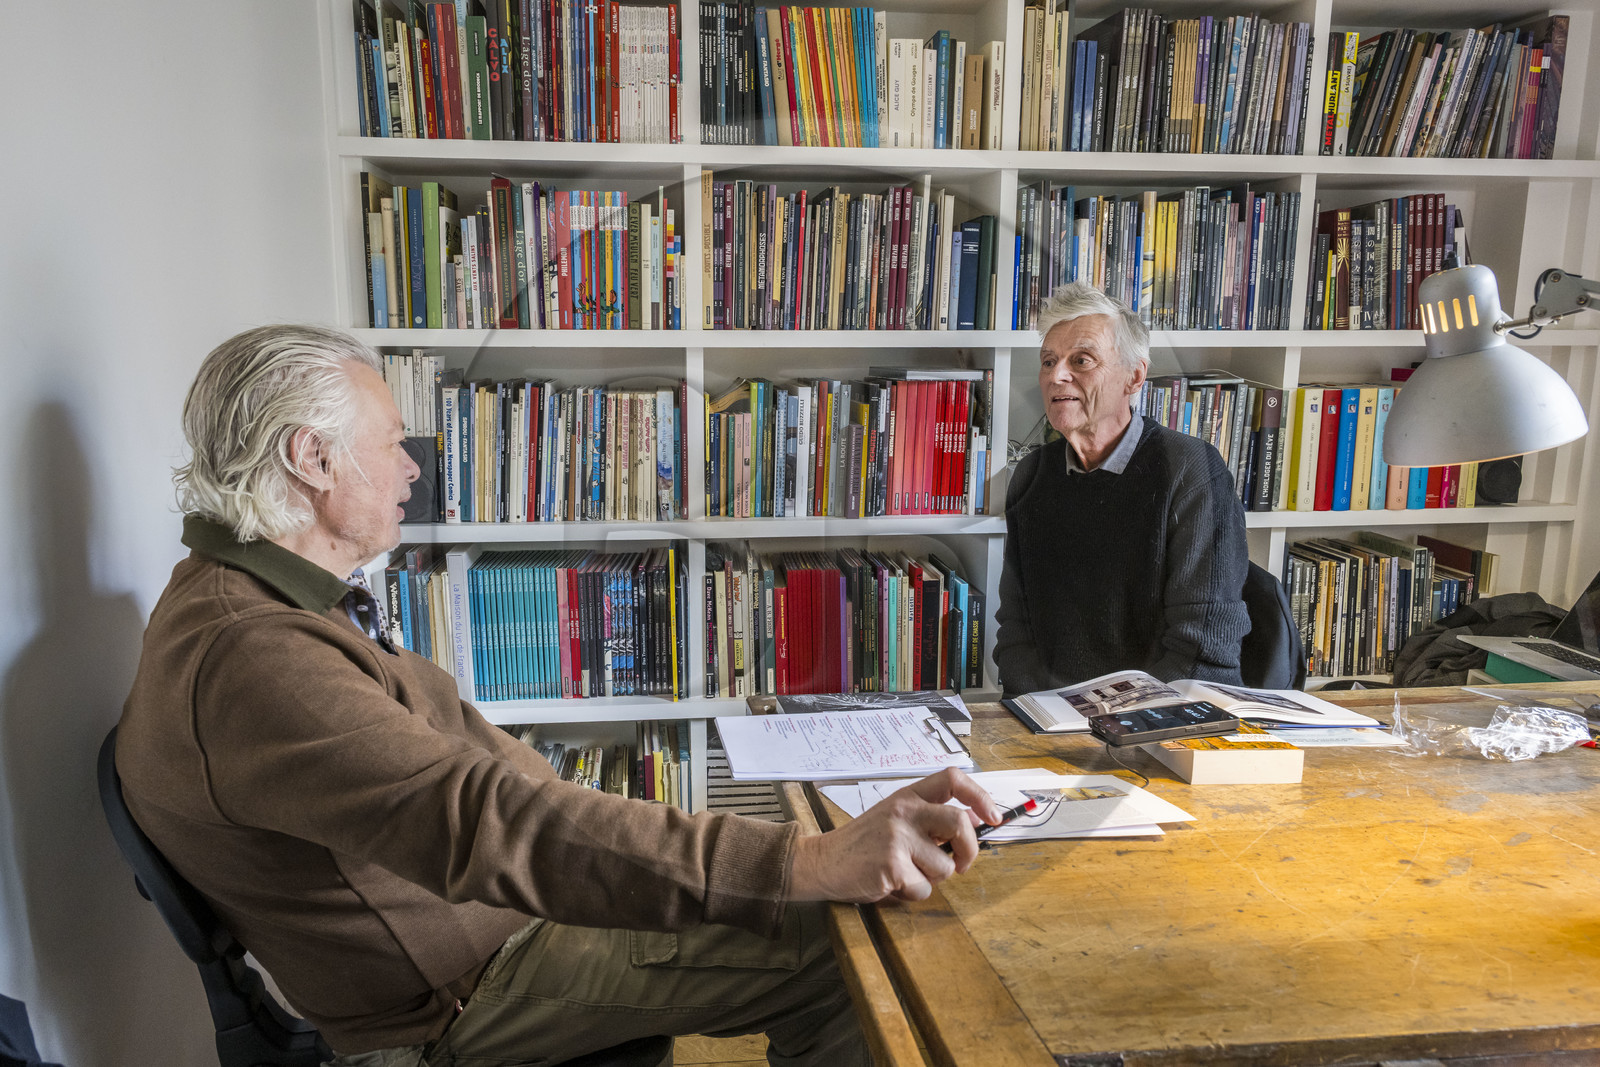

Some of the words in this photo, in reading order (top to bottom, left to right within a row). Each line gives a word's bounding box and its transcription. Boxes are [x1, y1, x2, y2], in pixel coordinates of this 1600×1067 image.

[488, 28, 500, 82] CALVO
[500, 39, 509, 74] ALIX
[521, 36, 531, 67] L'âge
[523, 70, 531, 92] d'or
[1328, 70, 1339, 114] HURLANT
[1324, 114, 1334, 145] METAL
[630, 217, 638, 232] EVER
[516, 229, 526, 258] L'âge
[630, 235, 638, 263] MEULEN
[518, 261, 526, 282] d'or
[869, 430, 877, 462] SCHUITEN
[1264, 434, 1274, 450] RÊVE
[446, 454, 454, 482] Newspaper
[840, 459, 845, 467] LA
[1266, 451, 1272, 460] DU
[1262, 461, 1272, 497] L'HORLOGER
[389, 581, 399, 616] WINSOR
[454, 584, 460, 592] La
[454, 594, 462, 620] Maison
[455, 632, 463, 644] Lys
[456, 622, 462, 631] du
[457, 645, 463, 653] de
[457, 655, 465, 678] France
